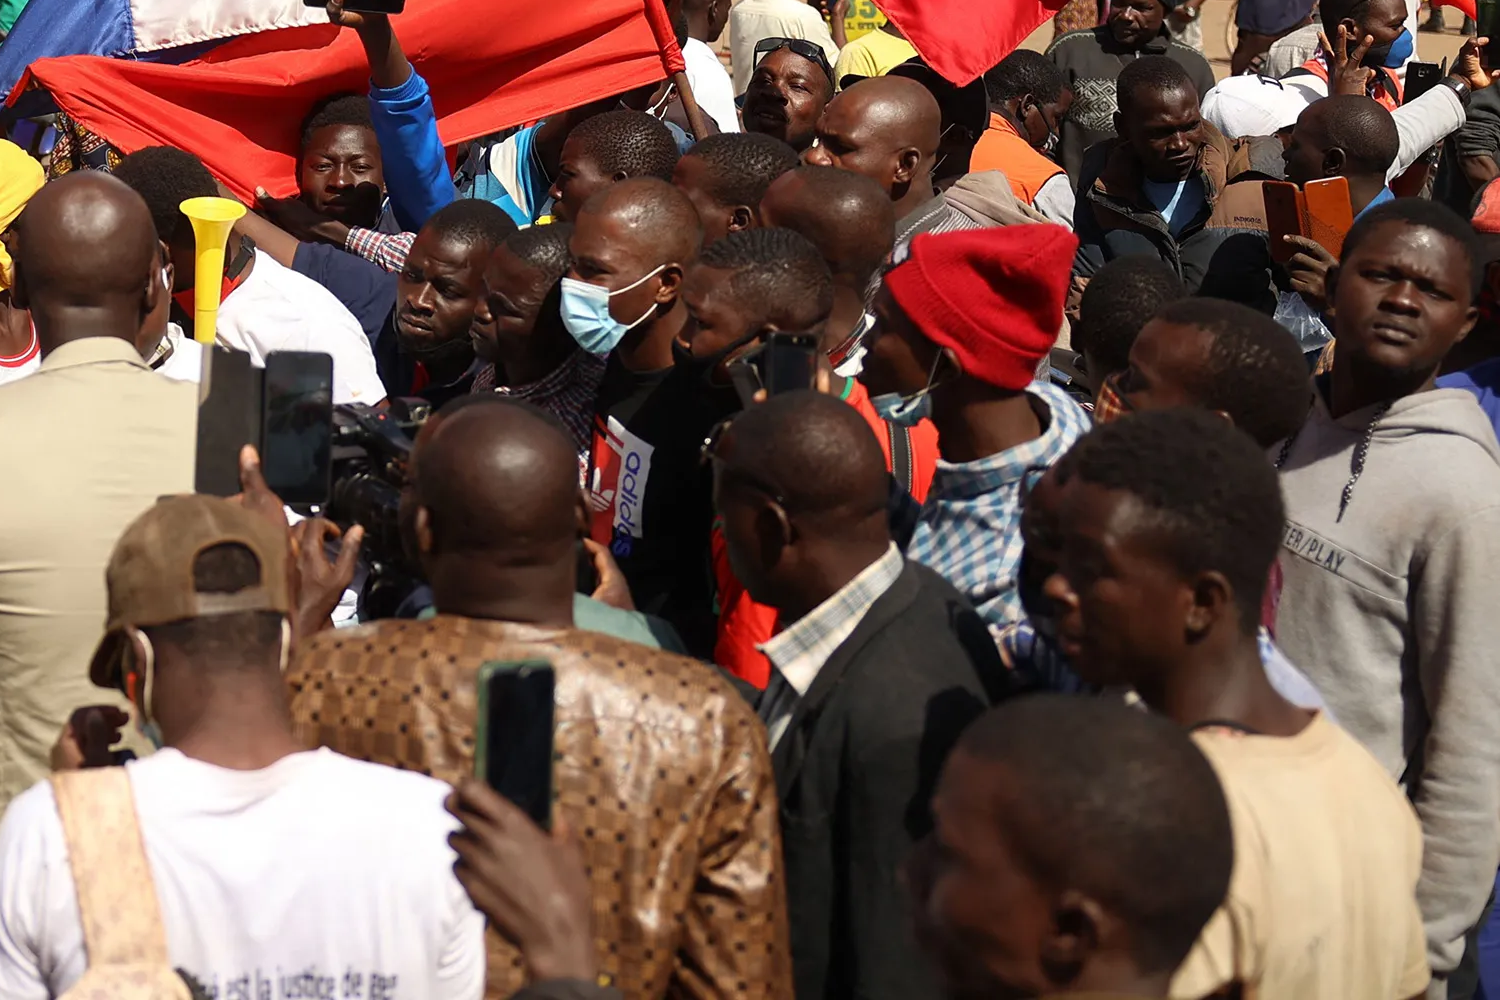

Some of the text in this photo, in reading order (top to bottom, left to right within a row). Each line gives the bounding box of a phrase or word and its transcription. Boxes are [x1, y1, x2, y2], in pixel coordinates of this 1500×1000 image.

[613, 451, 641, 557] adidas
[256, 967, 271, 1000] la
[275, 965, 335, 1000] justice
[343, 964, 362, 998] de
